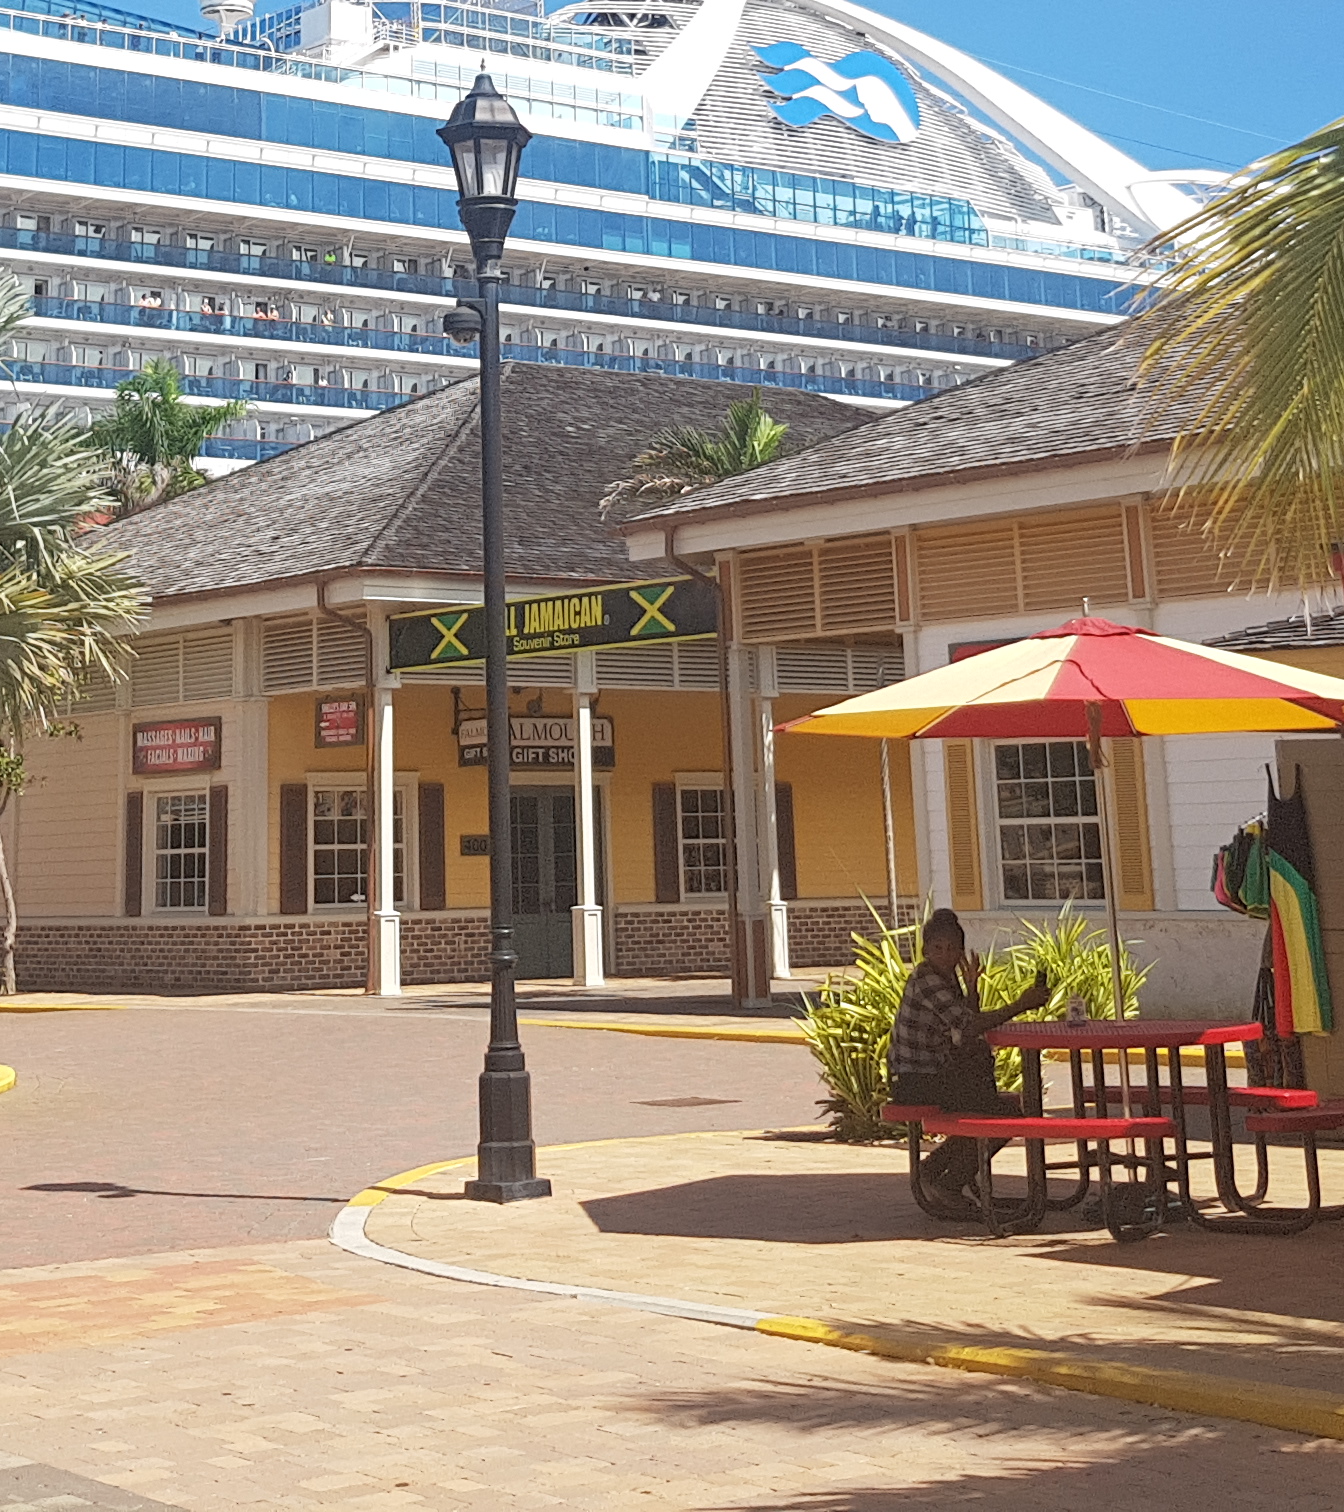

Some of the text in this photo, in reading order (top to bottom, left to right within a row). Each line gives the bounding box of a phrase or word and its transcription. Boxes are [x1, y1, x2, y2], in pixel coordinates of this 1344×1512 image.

[523, 595, 602, 634] JAMAICAN
[513, 631, 580, 651] Souvenir Store
[137, 725, 215, 747] MASSAGES NAILS HAIR
[147, 746, 204, 765] FACIALS WAXING
[512, 747, 545, 763] GIFT
